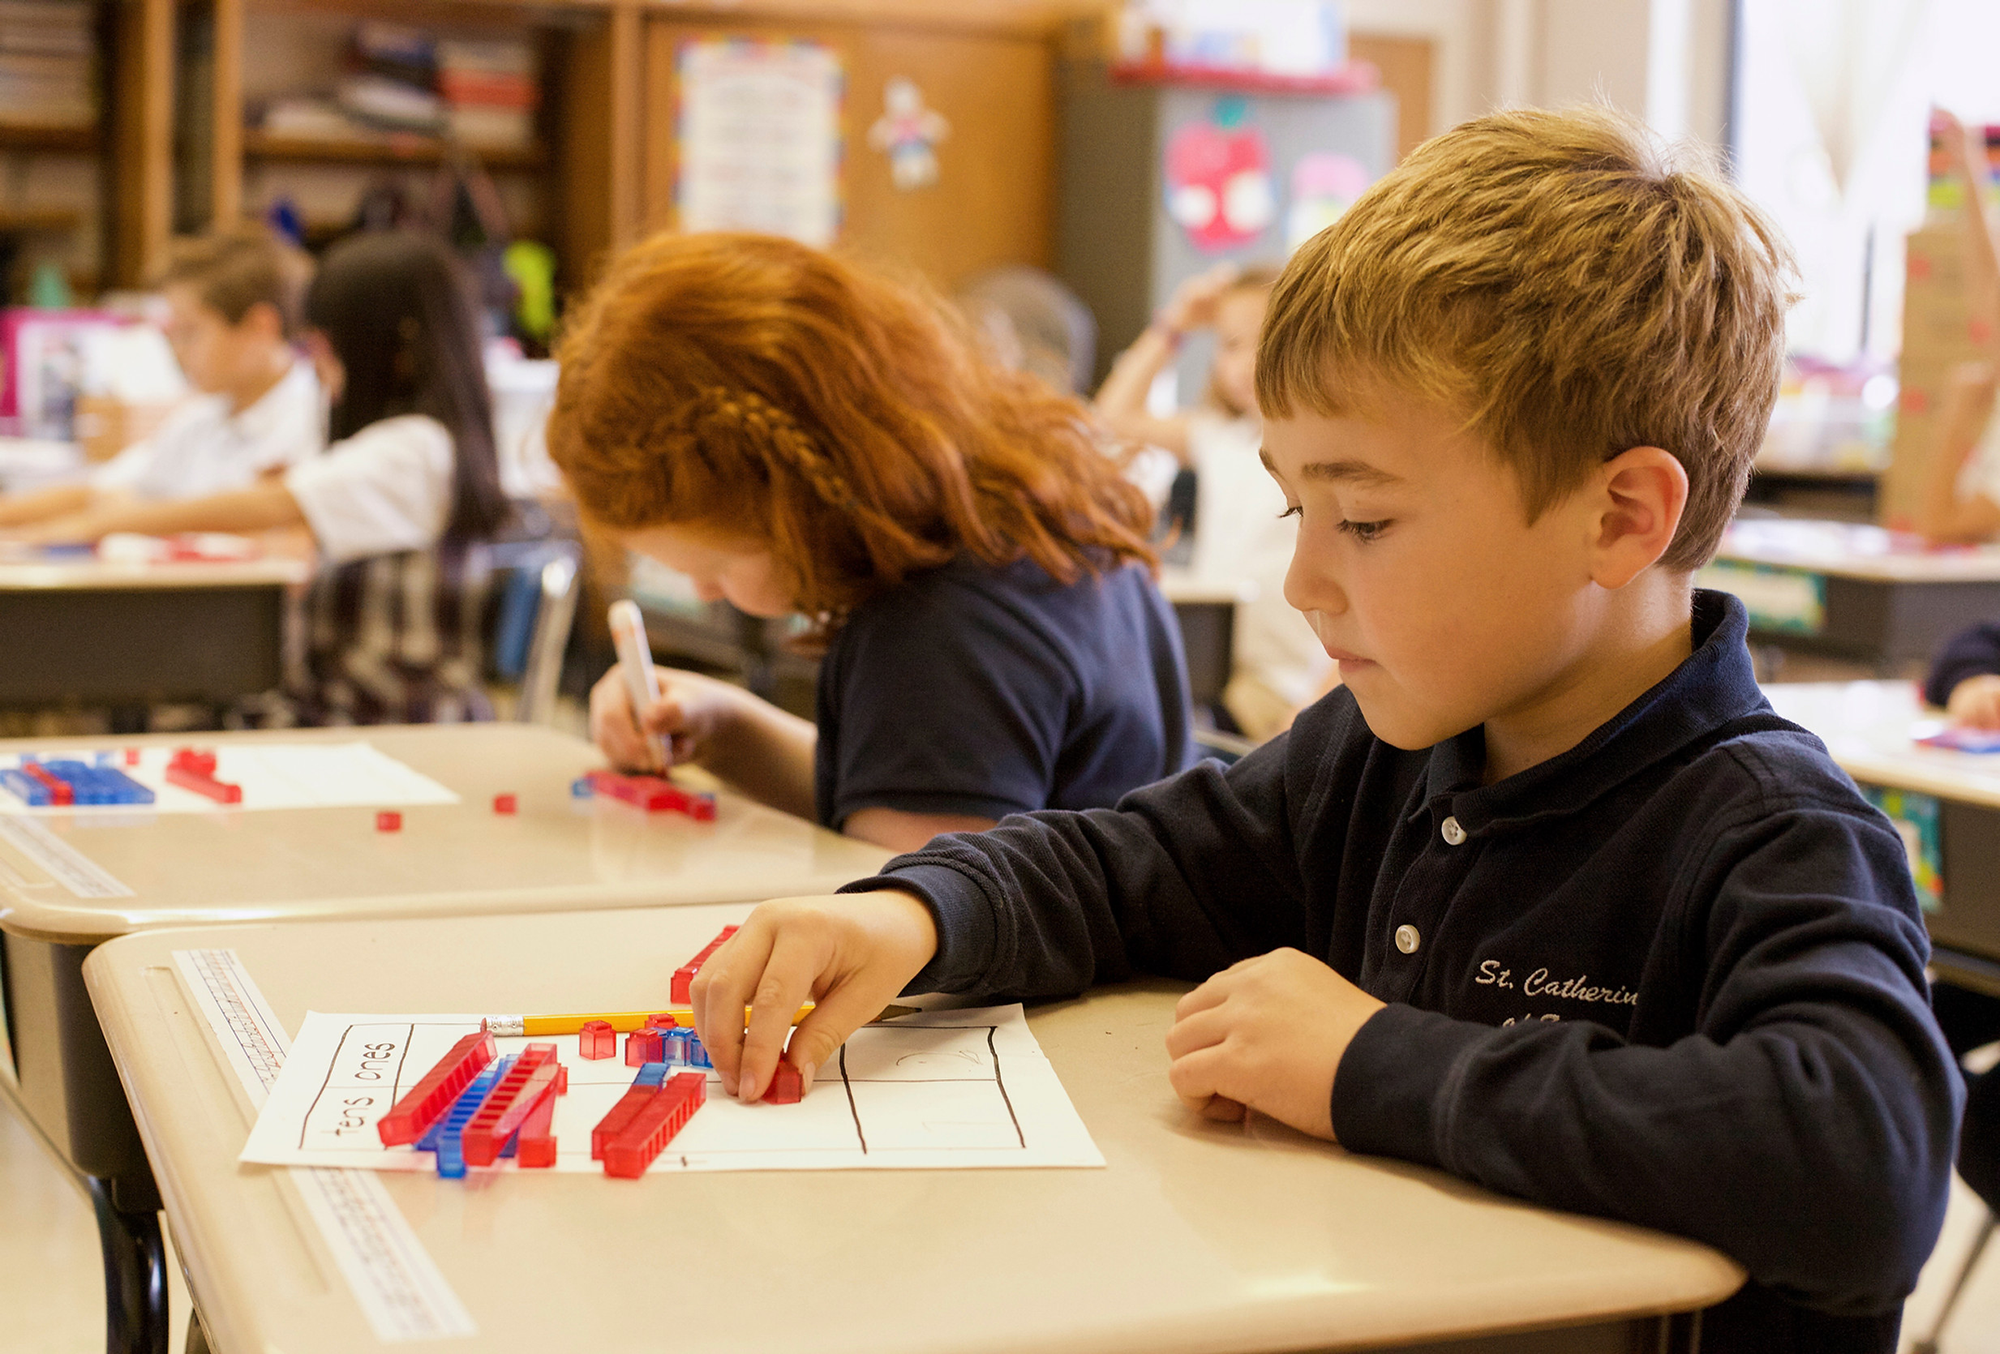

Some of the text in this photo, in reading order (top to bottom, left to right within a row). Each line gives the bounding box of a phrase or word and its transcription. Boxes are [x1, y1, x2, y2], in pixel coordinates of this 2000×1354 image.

[1475, 959, 1639, 1005] St. Catherin
[354, 1042, 396, 1081] ones
[320, 1096, 375, 1137] tens
